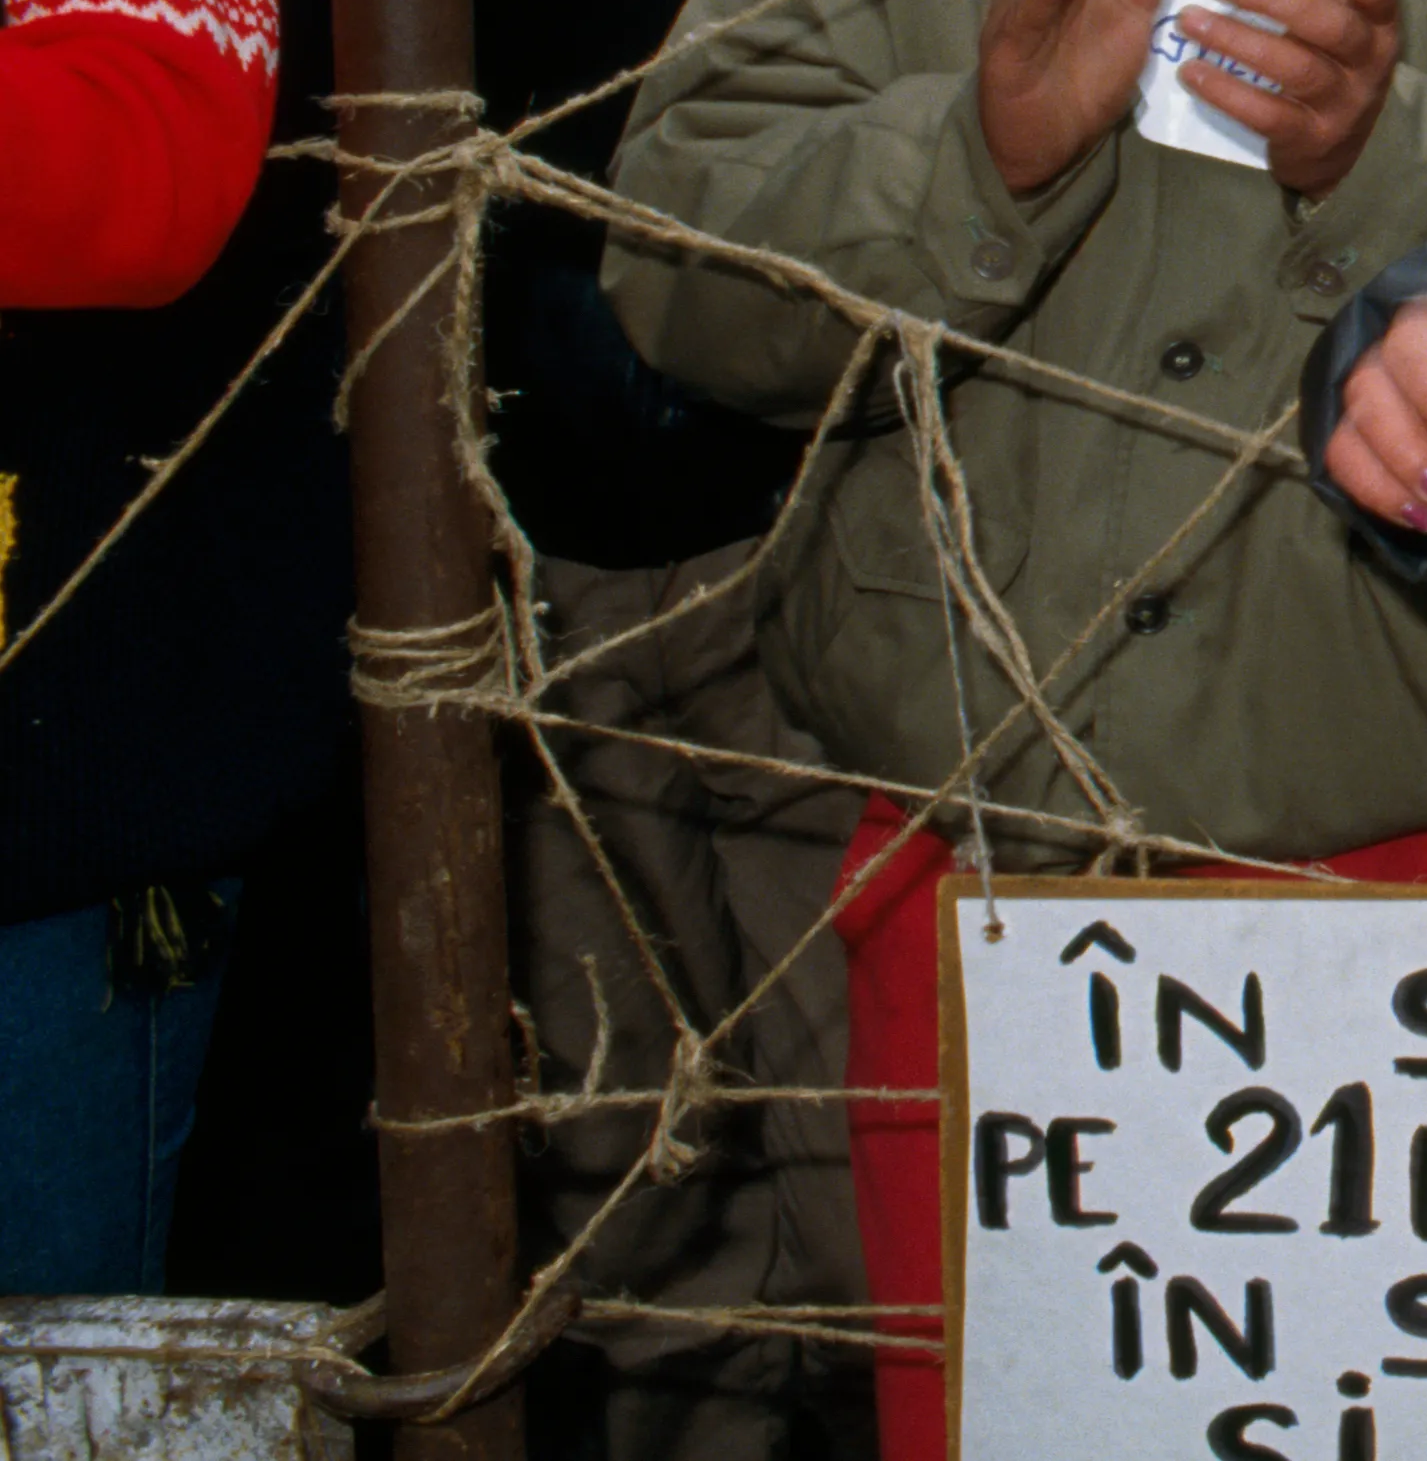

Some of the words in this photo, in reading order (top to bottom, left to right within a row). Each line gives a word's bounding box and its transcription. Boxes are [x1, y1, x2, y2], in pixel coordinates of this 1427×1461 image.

[1061, 921, 1264, 1072] ÎN
[974, 1112, 1117, 1230] PE
[1190, 1082, 1378, 1238] 21
[1097, 1242, 1274, 1381] ÎN
